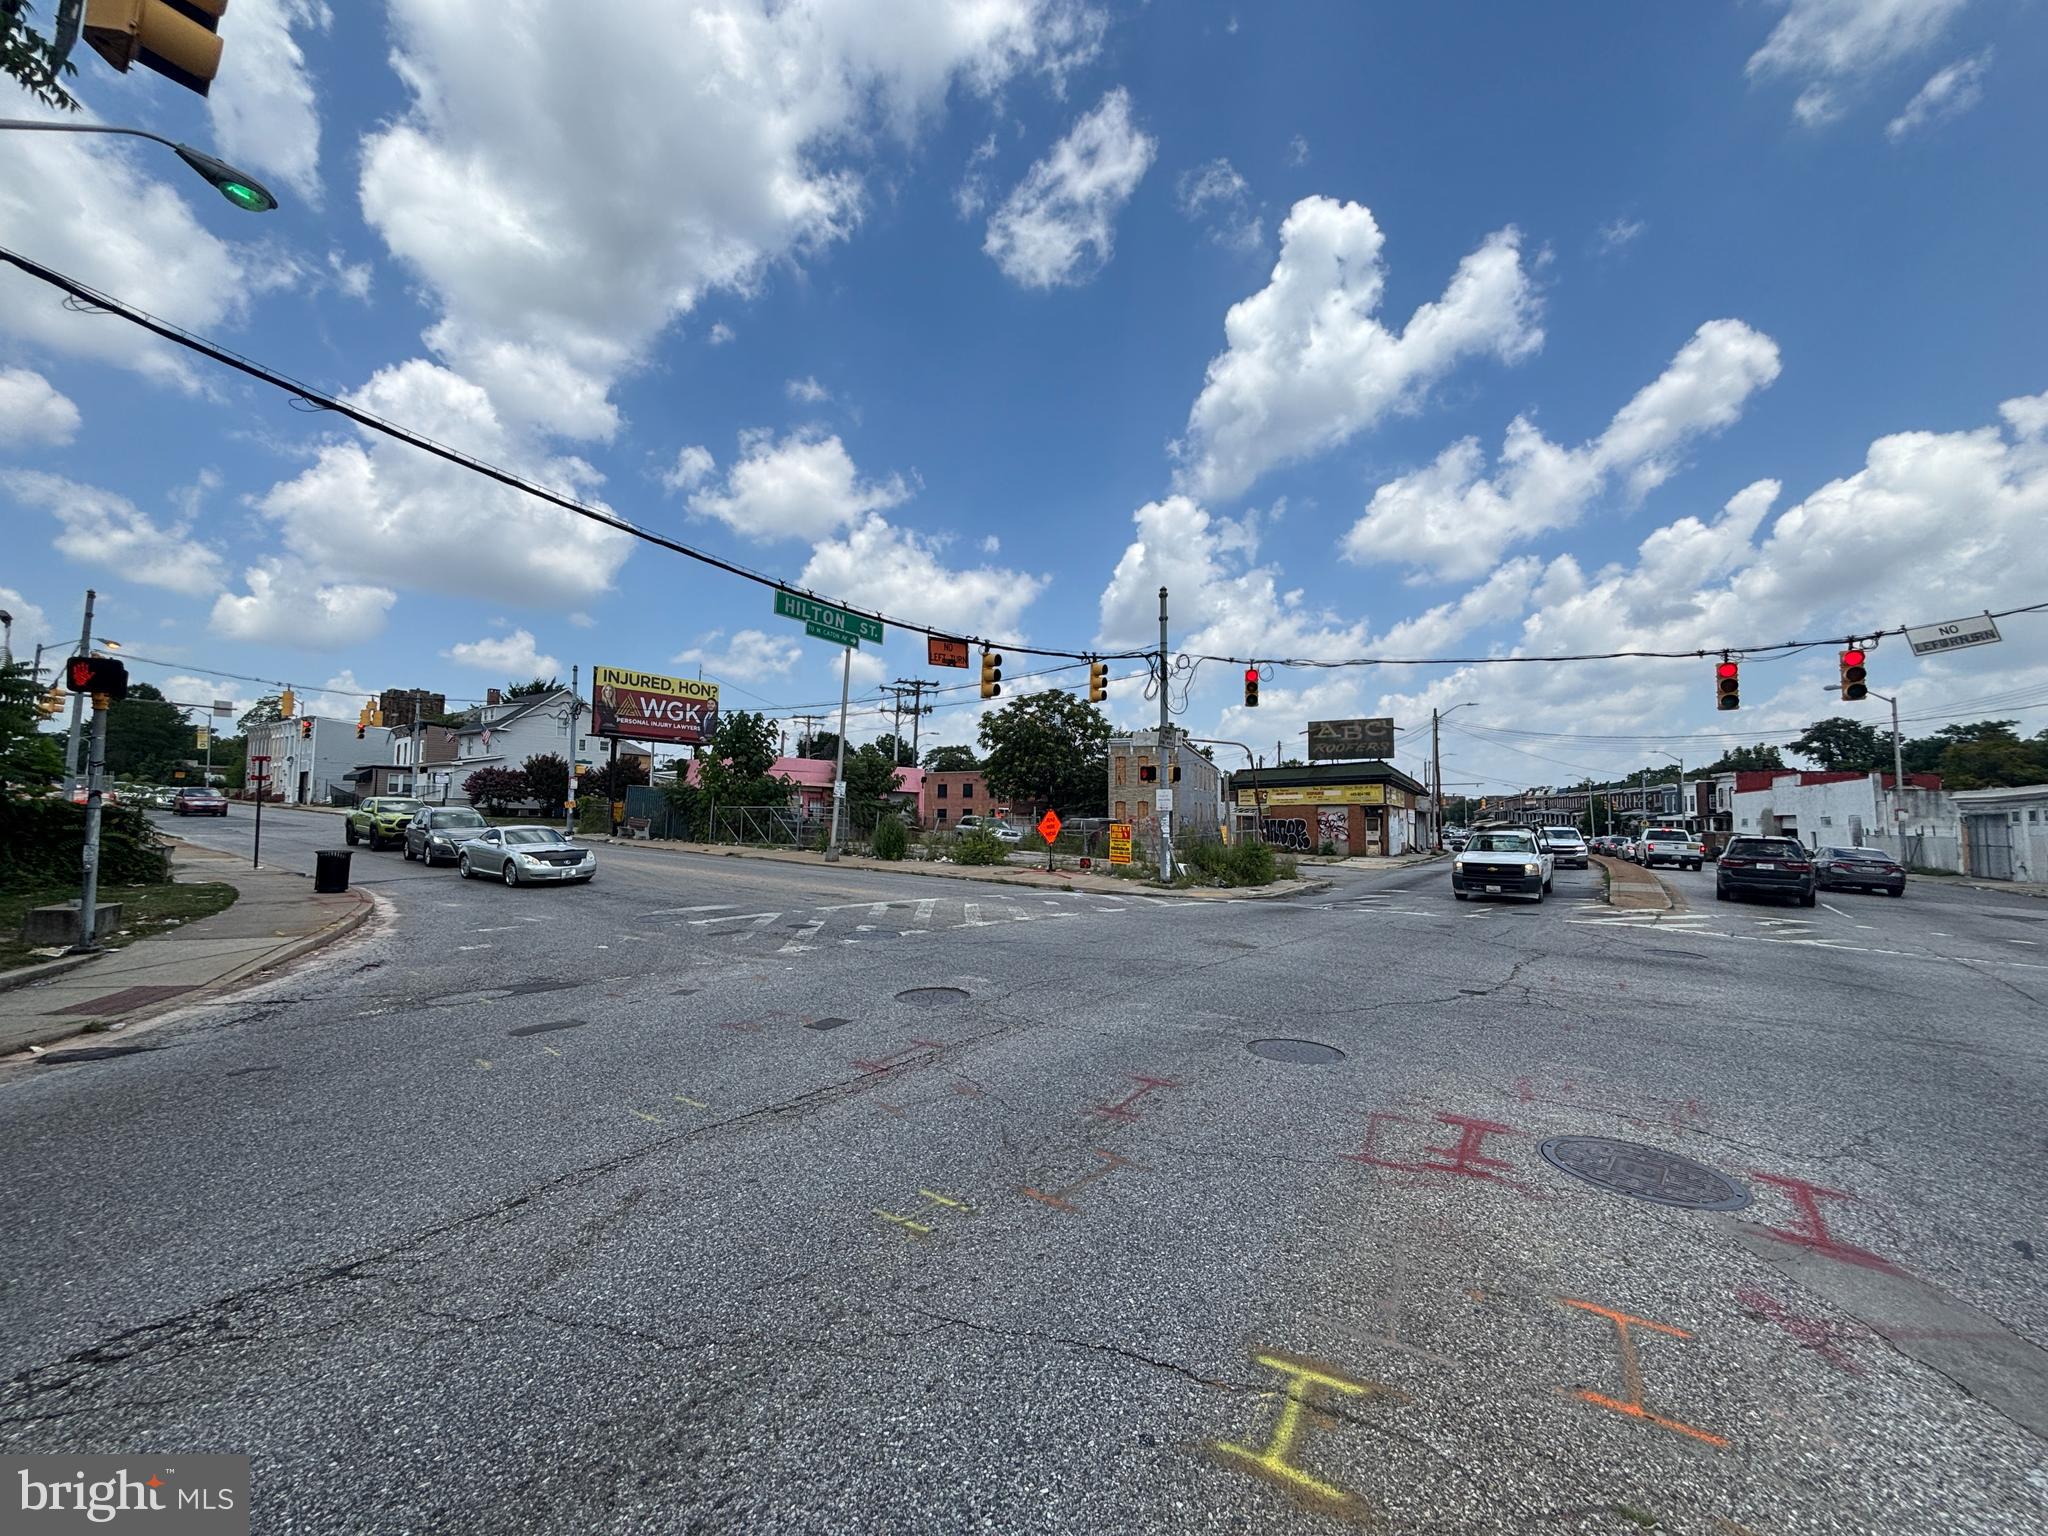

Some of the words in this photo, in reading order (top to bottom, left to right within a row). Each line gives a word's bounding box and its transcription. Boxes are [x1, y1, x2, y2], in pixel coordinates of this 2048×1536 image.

[784, 597, 845, 629] HILTON
[859, 622, 878, 638] ST.
[1938, 625, 1959, 636] NO
[944, 642, 953, 652] NO
[603, 669, 675, 694] INJURED,
[679, 681, 718, 697] HON?
[640, 697, 701, 723] WGK
[616, 717, 649, 726] PERSONAL
[651, 721, 672, 729] INJURY
[673, 723, 700, 731] LAWYERS
[1313, 721, 1390, 740] ABC
[1313, 741, 1390, 753] ROOFERS
